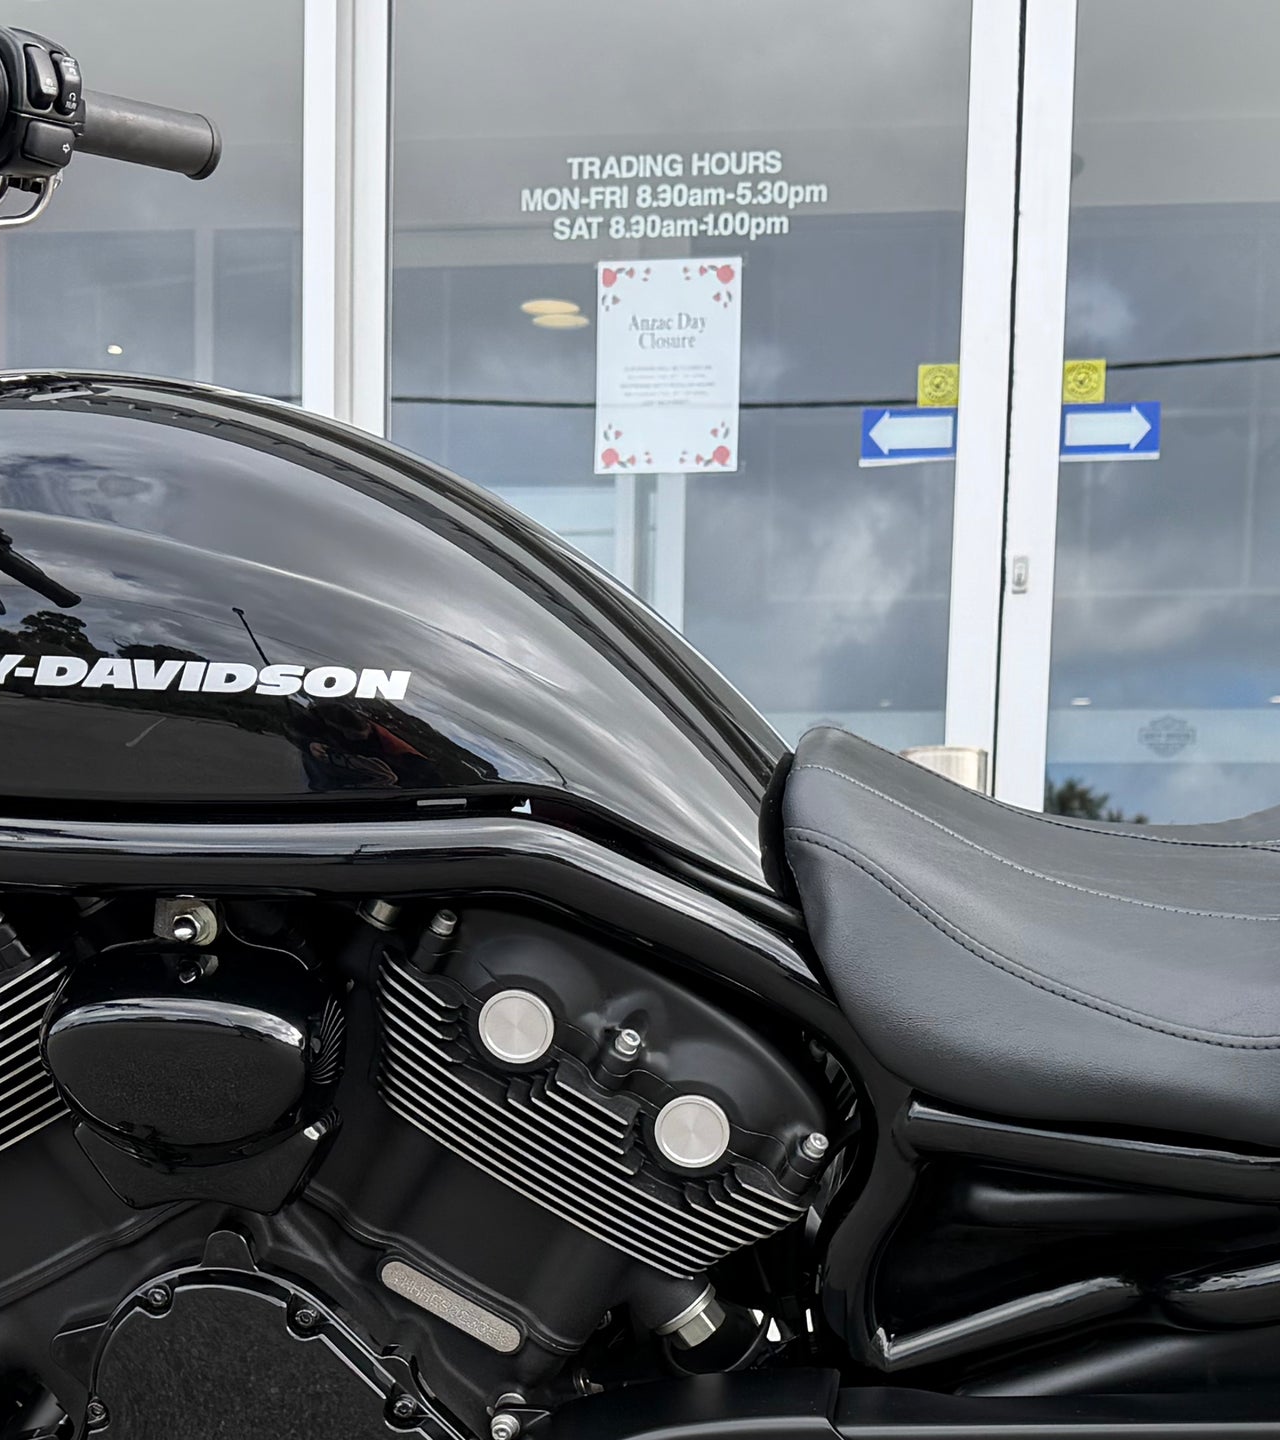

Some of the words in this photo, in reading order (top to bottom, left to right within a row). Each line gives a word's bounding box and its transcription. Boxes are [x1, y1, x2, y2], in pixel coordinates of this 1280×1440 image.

[567, 153, 683, 180] TRADING
[691, 150, 782, 176] HOURS
[521, 186, 629, 212] MON-FRI
[636, 181, 828, 209] 8.30am-5.30pm
[553, 217, 603, 241] SAT
[629, 314, 674, 331] Anzac
[677, 313, 707, 333] Day
[638, 332, 696, 349] Closure
